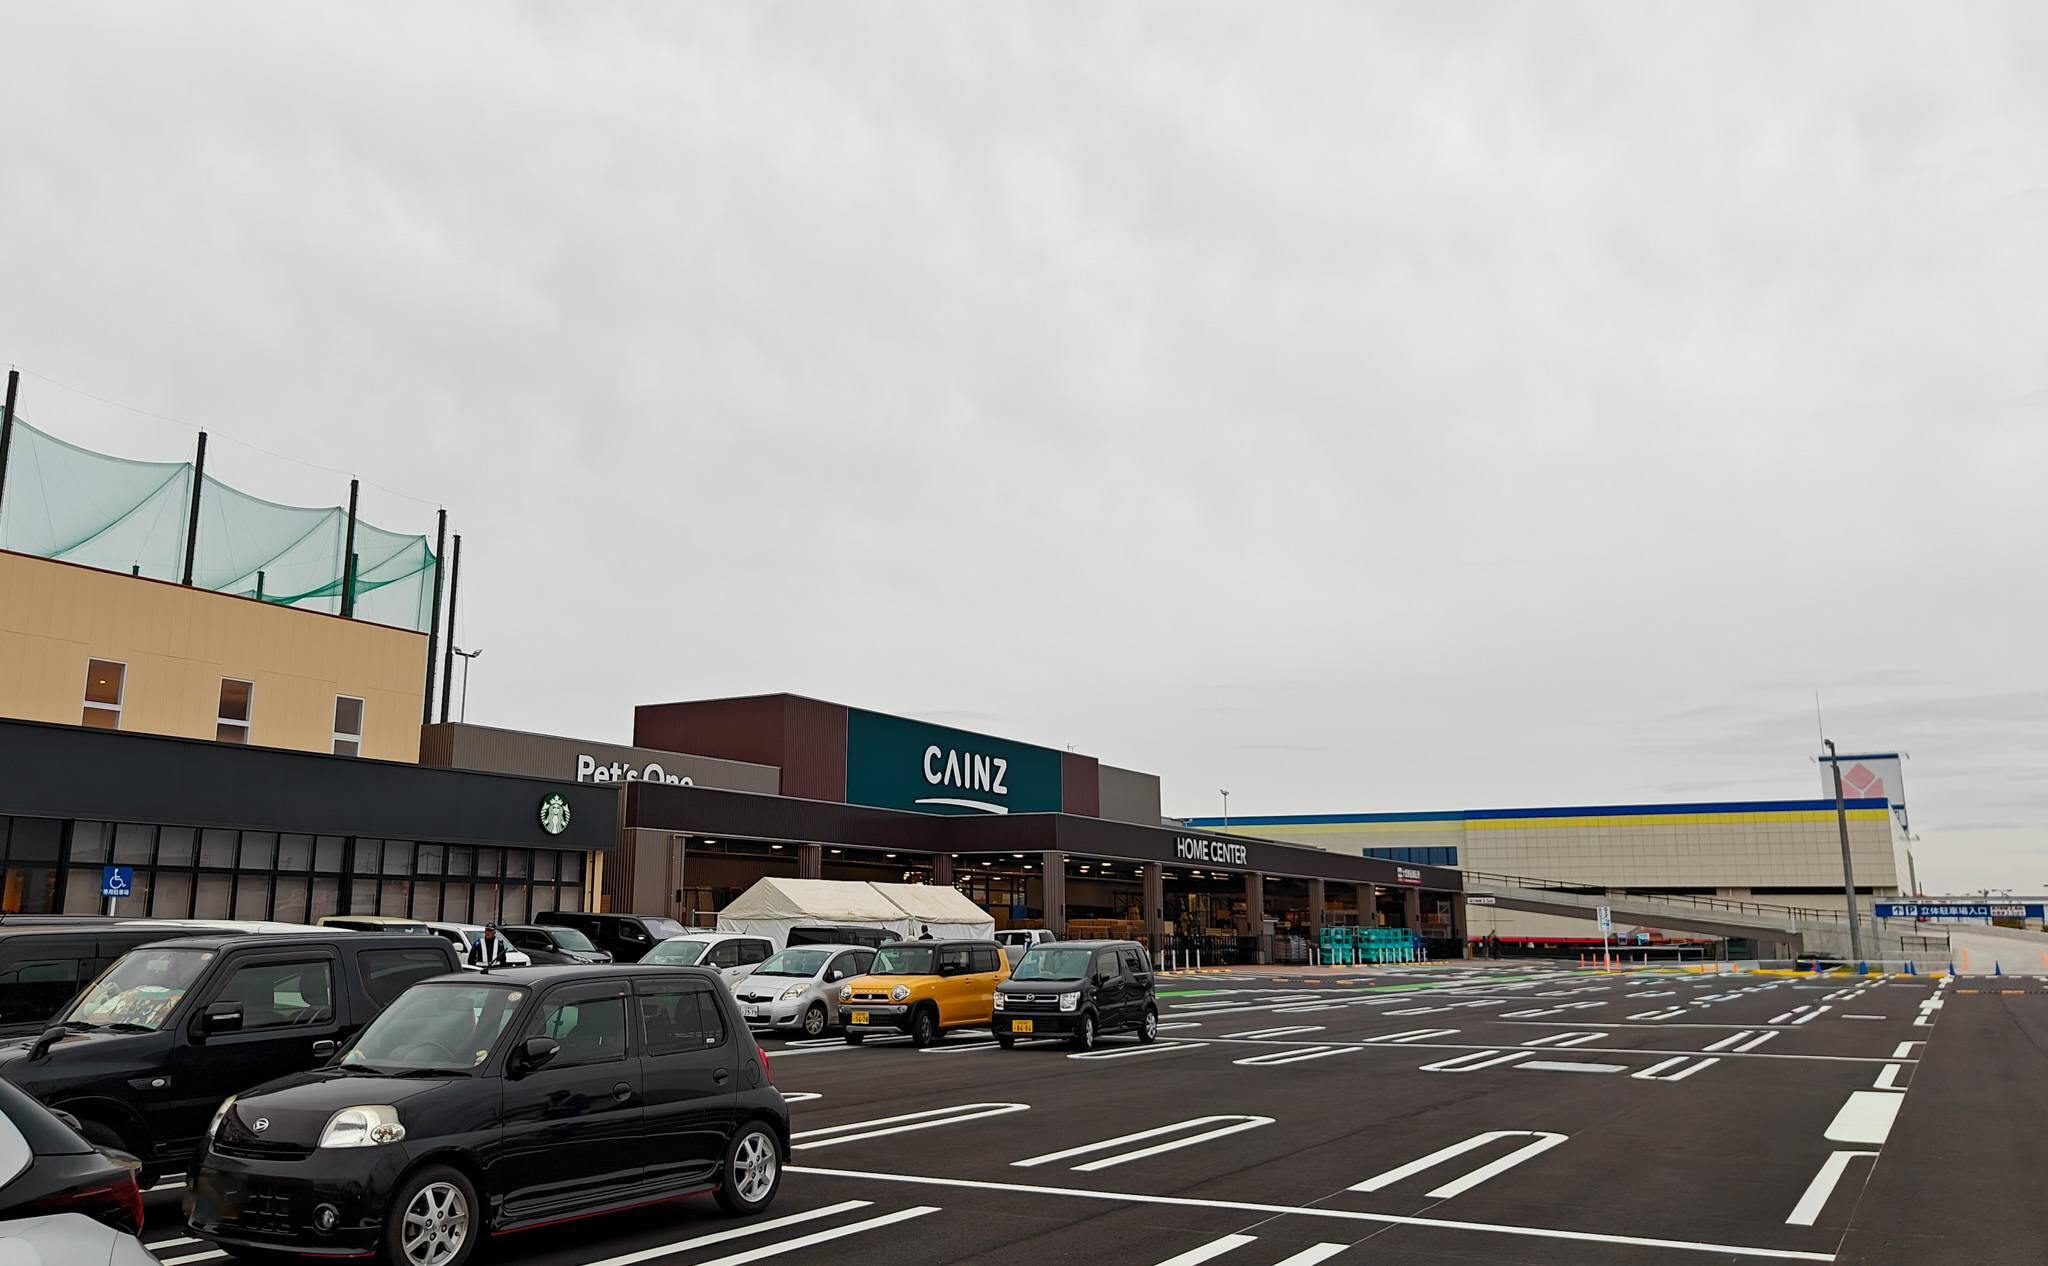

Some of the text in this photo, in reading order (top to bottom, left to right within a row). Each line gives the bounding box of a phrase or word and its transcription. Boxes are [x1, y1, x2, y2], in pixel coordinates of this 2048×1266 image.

[577, 754, 638, 783] Pet's
[923, 745, 1008, 794] CAINZ
[1177, 837, 1247, 864] HOME CENTER
